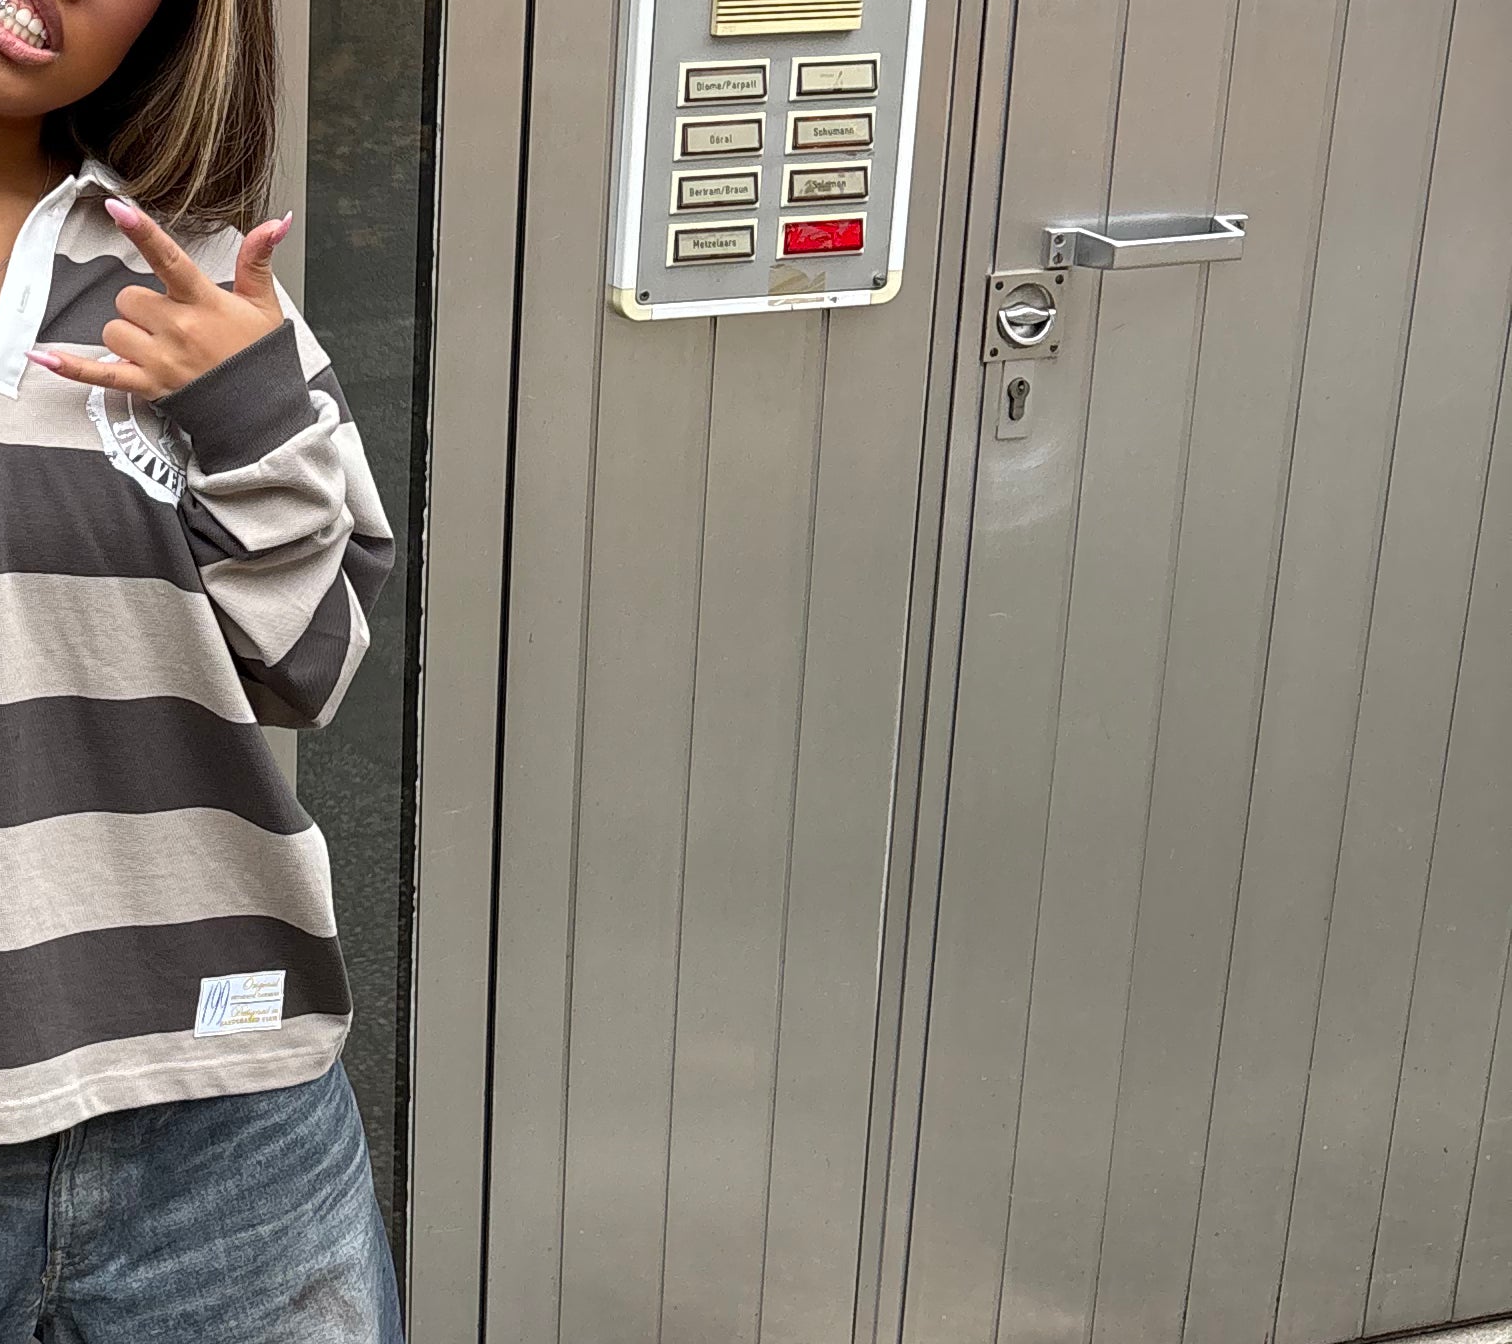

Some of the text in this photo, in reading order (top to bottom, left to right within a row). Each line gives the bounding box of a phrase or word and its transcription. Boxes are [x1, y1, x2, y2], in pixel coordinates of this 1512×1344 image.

[813, 127, 855, 137] Schumann
[689, 184, 749, 197] Bertram/Braun
[692, 238, 737, 249] Metzelaars
